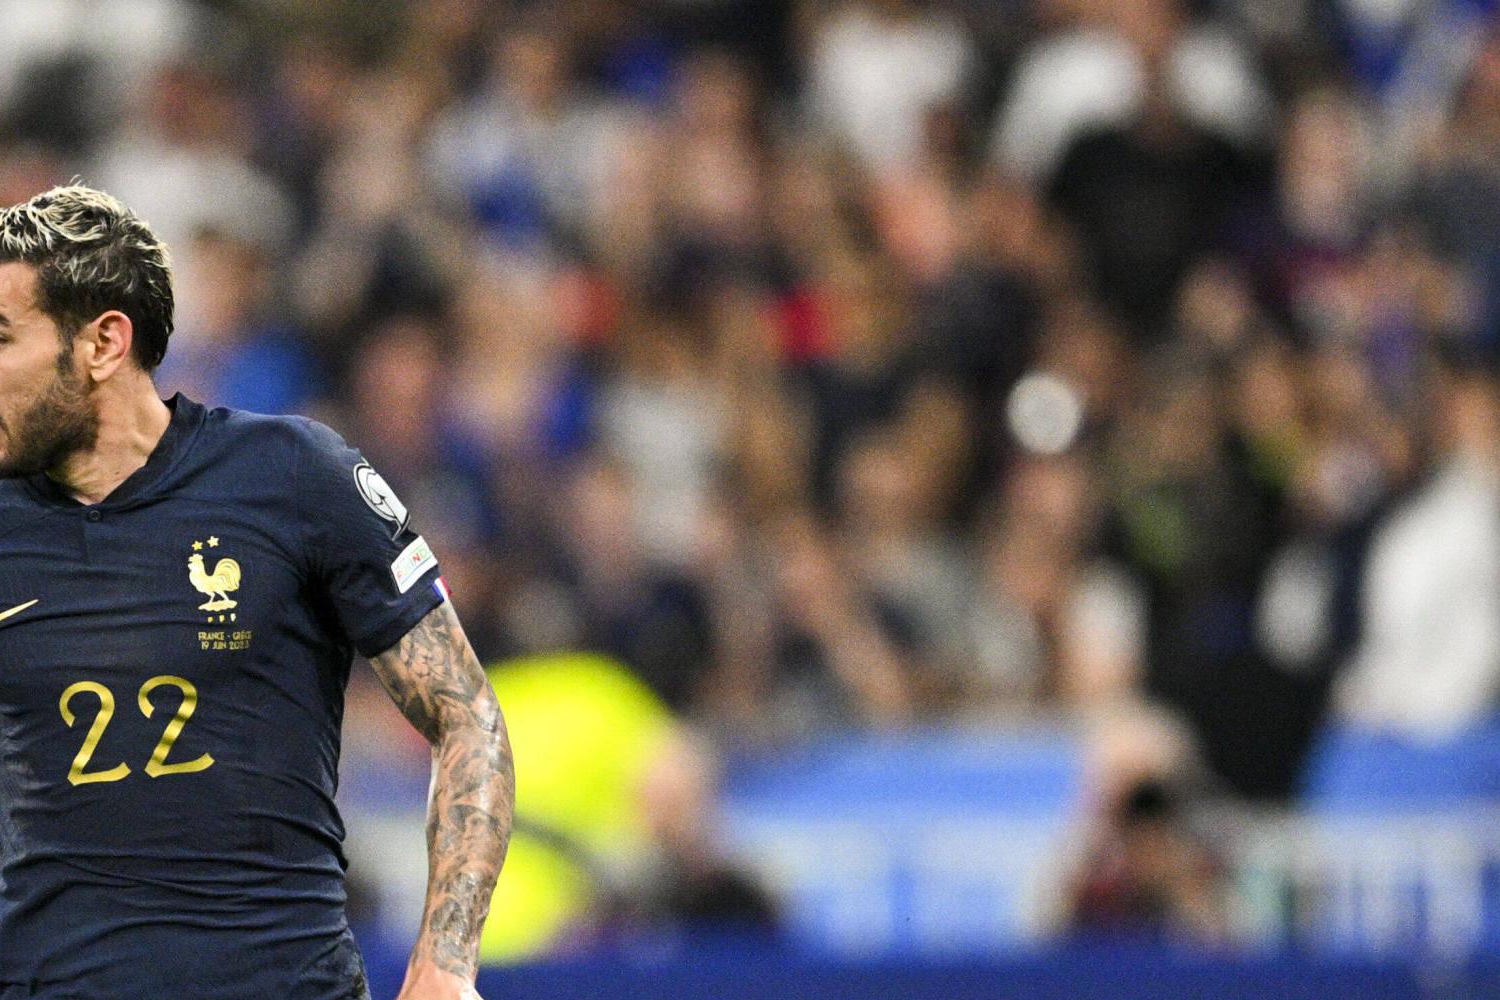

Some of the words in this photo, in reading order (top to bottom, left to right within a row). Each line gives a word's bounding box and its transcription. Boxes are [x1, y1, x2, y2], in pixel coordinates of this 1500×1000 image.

[198, 631, 225, 641] FRANCE
[201, 641, 209, 650] 19
[212, 641, 226, 650] JUIN
[58, 674, 215, 786] 22
